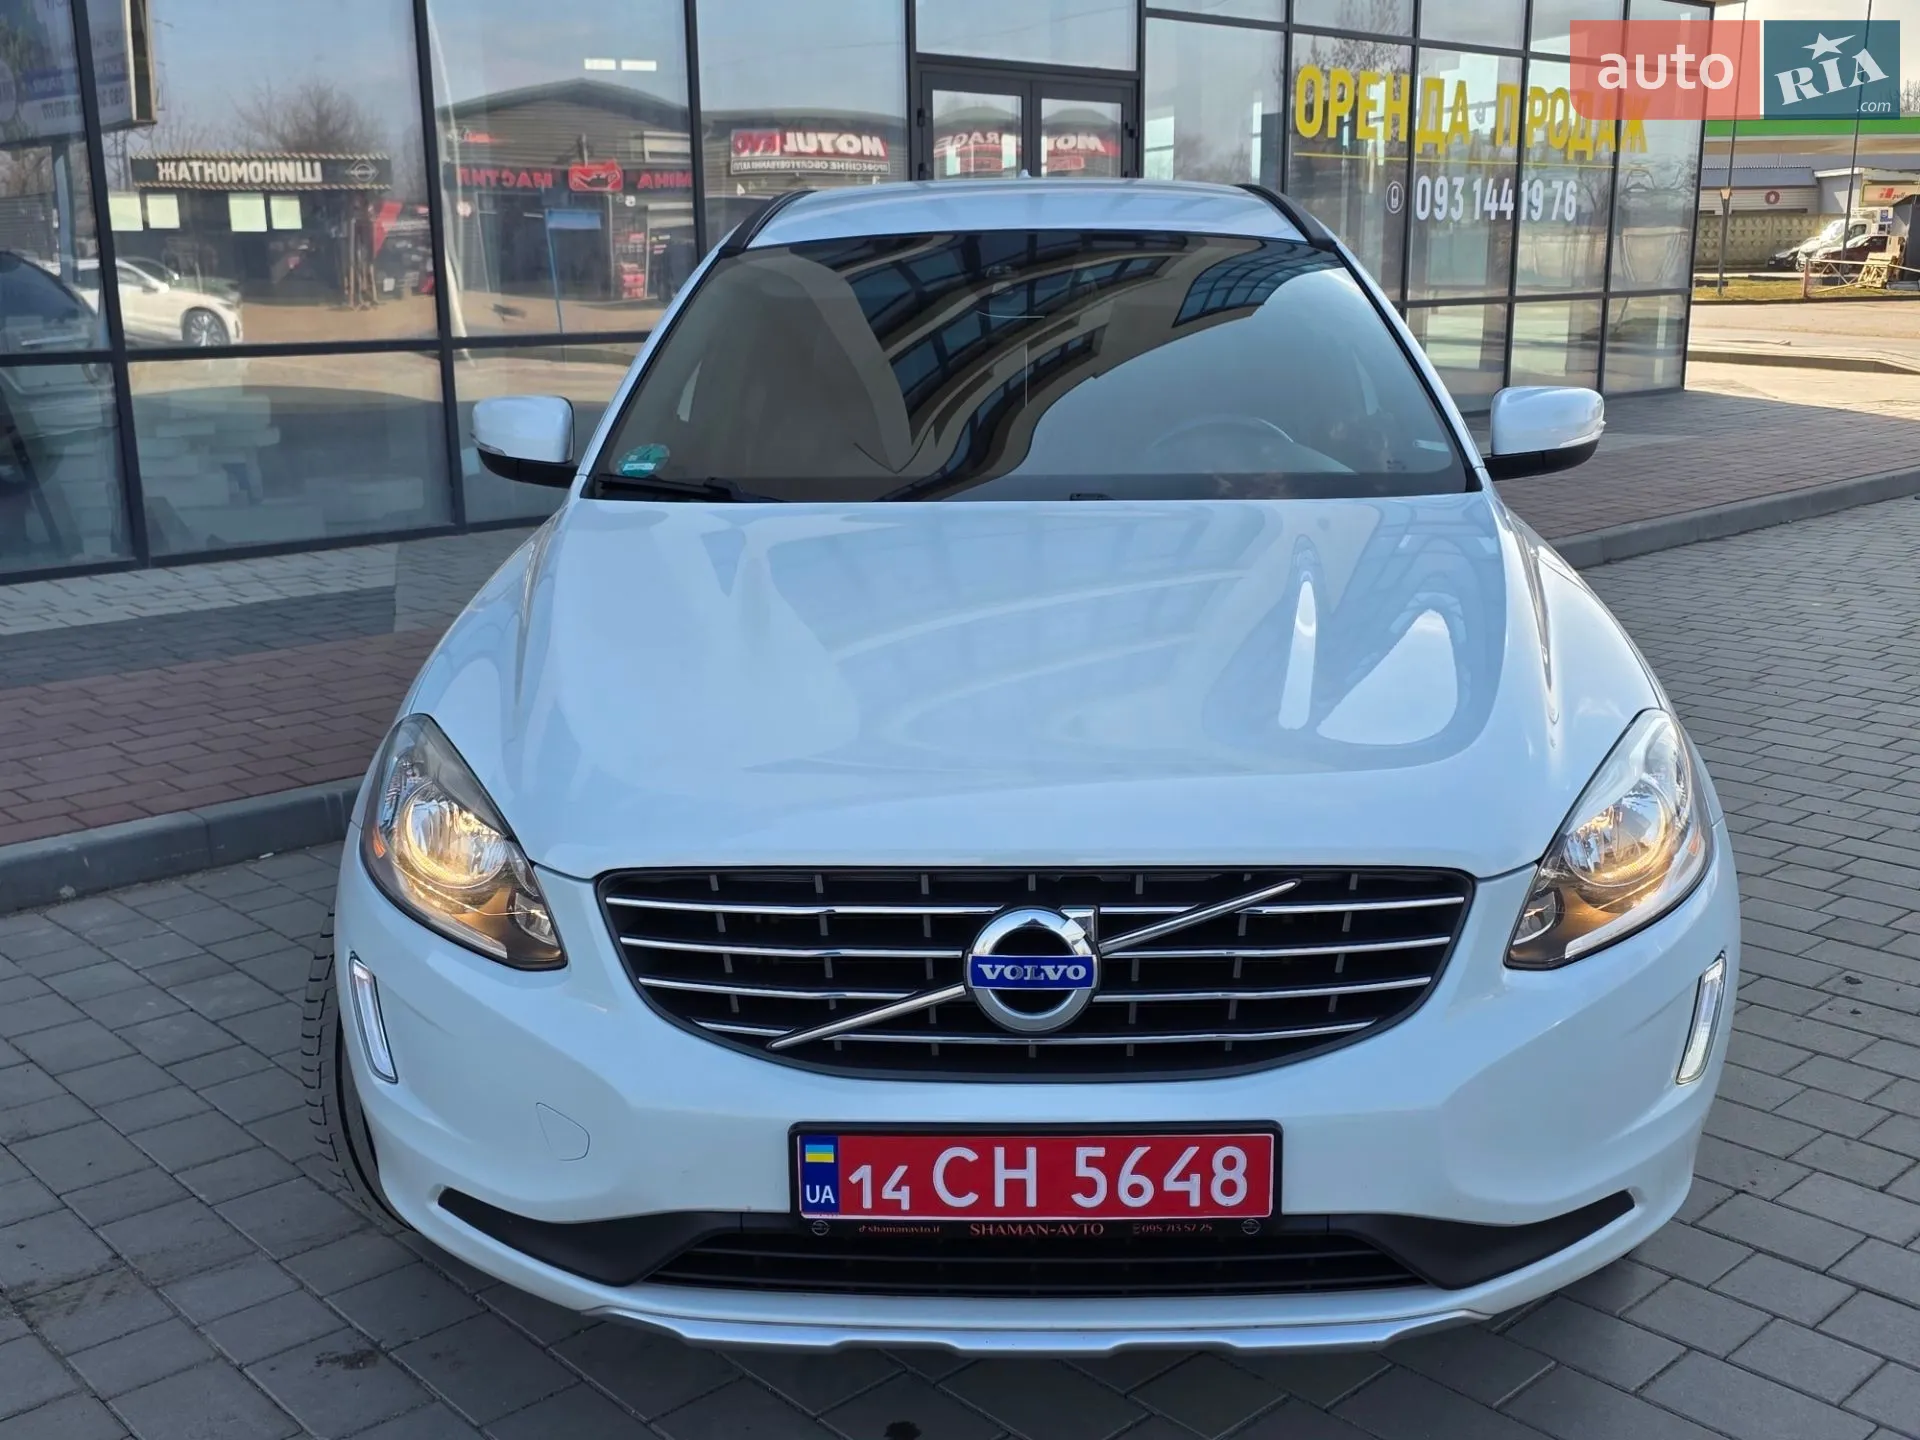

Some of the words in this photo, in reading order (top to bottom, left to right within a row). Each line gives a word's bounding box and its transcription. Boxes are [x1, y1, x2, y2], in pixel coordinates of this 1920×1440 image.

[1294, 64, 1470, 154] ОРЕНДА
[1495, 82, 1650, 161] ПРОДАЖ
[1416, 175, 1464, 222] 093
[1473, 177, 1514, 221] 144
[1520, 178, 1544, 221] 19
[1551, 181, 1577, 222] 76
[977, 963, 1087, 981] VOLVO
[806, 1185, 835, 1204] UA
[848, 1165, 910, 1210] 14
[932, 1146, 1037, 1208] CH
[1071, 1146, 1248, 1208] 5648
[970, 1222, 1104, 1236] SHAMAN-AVTO
